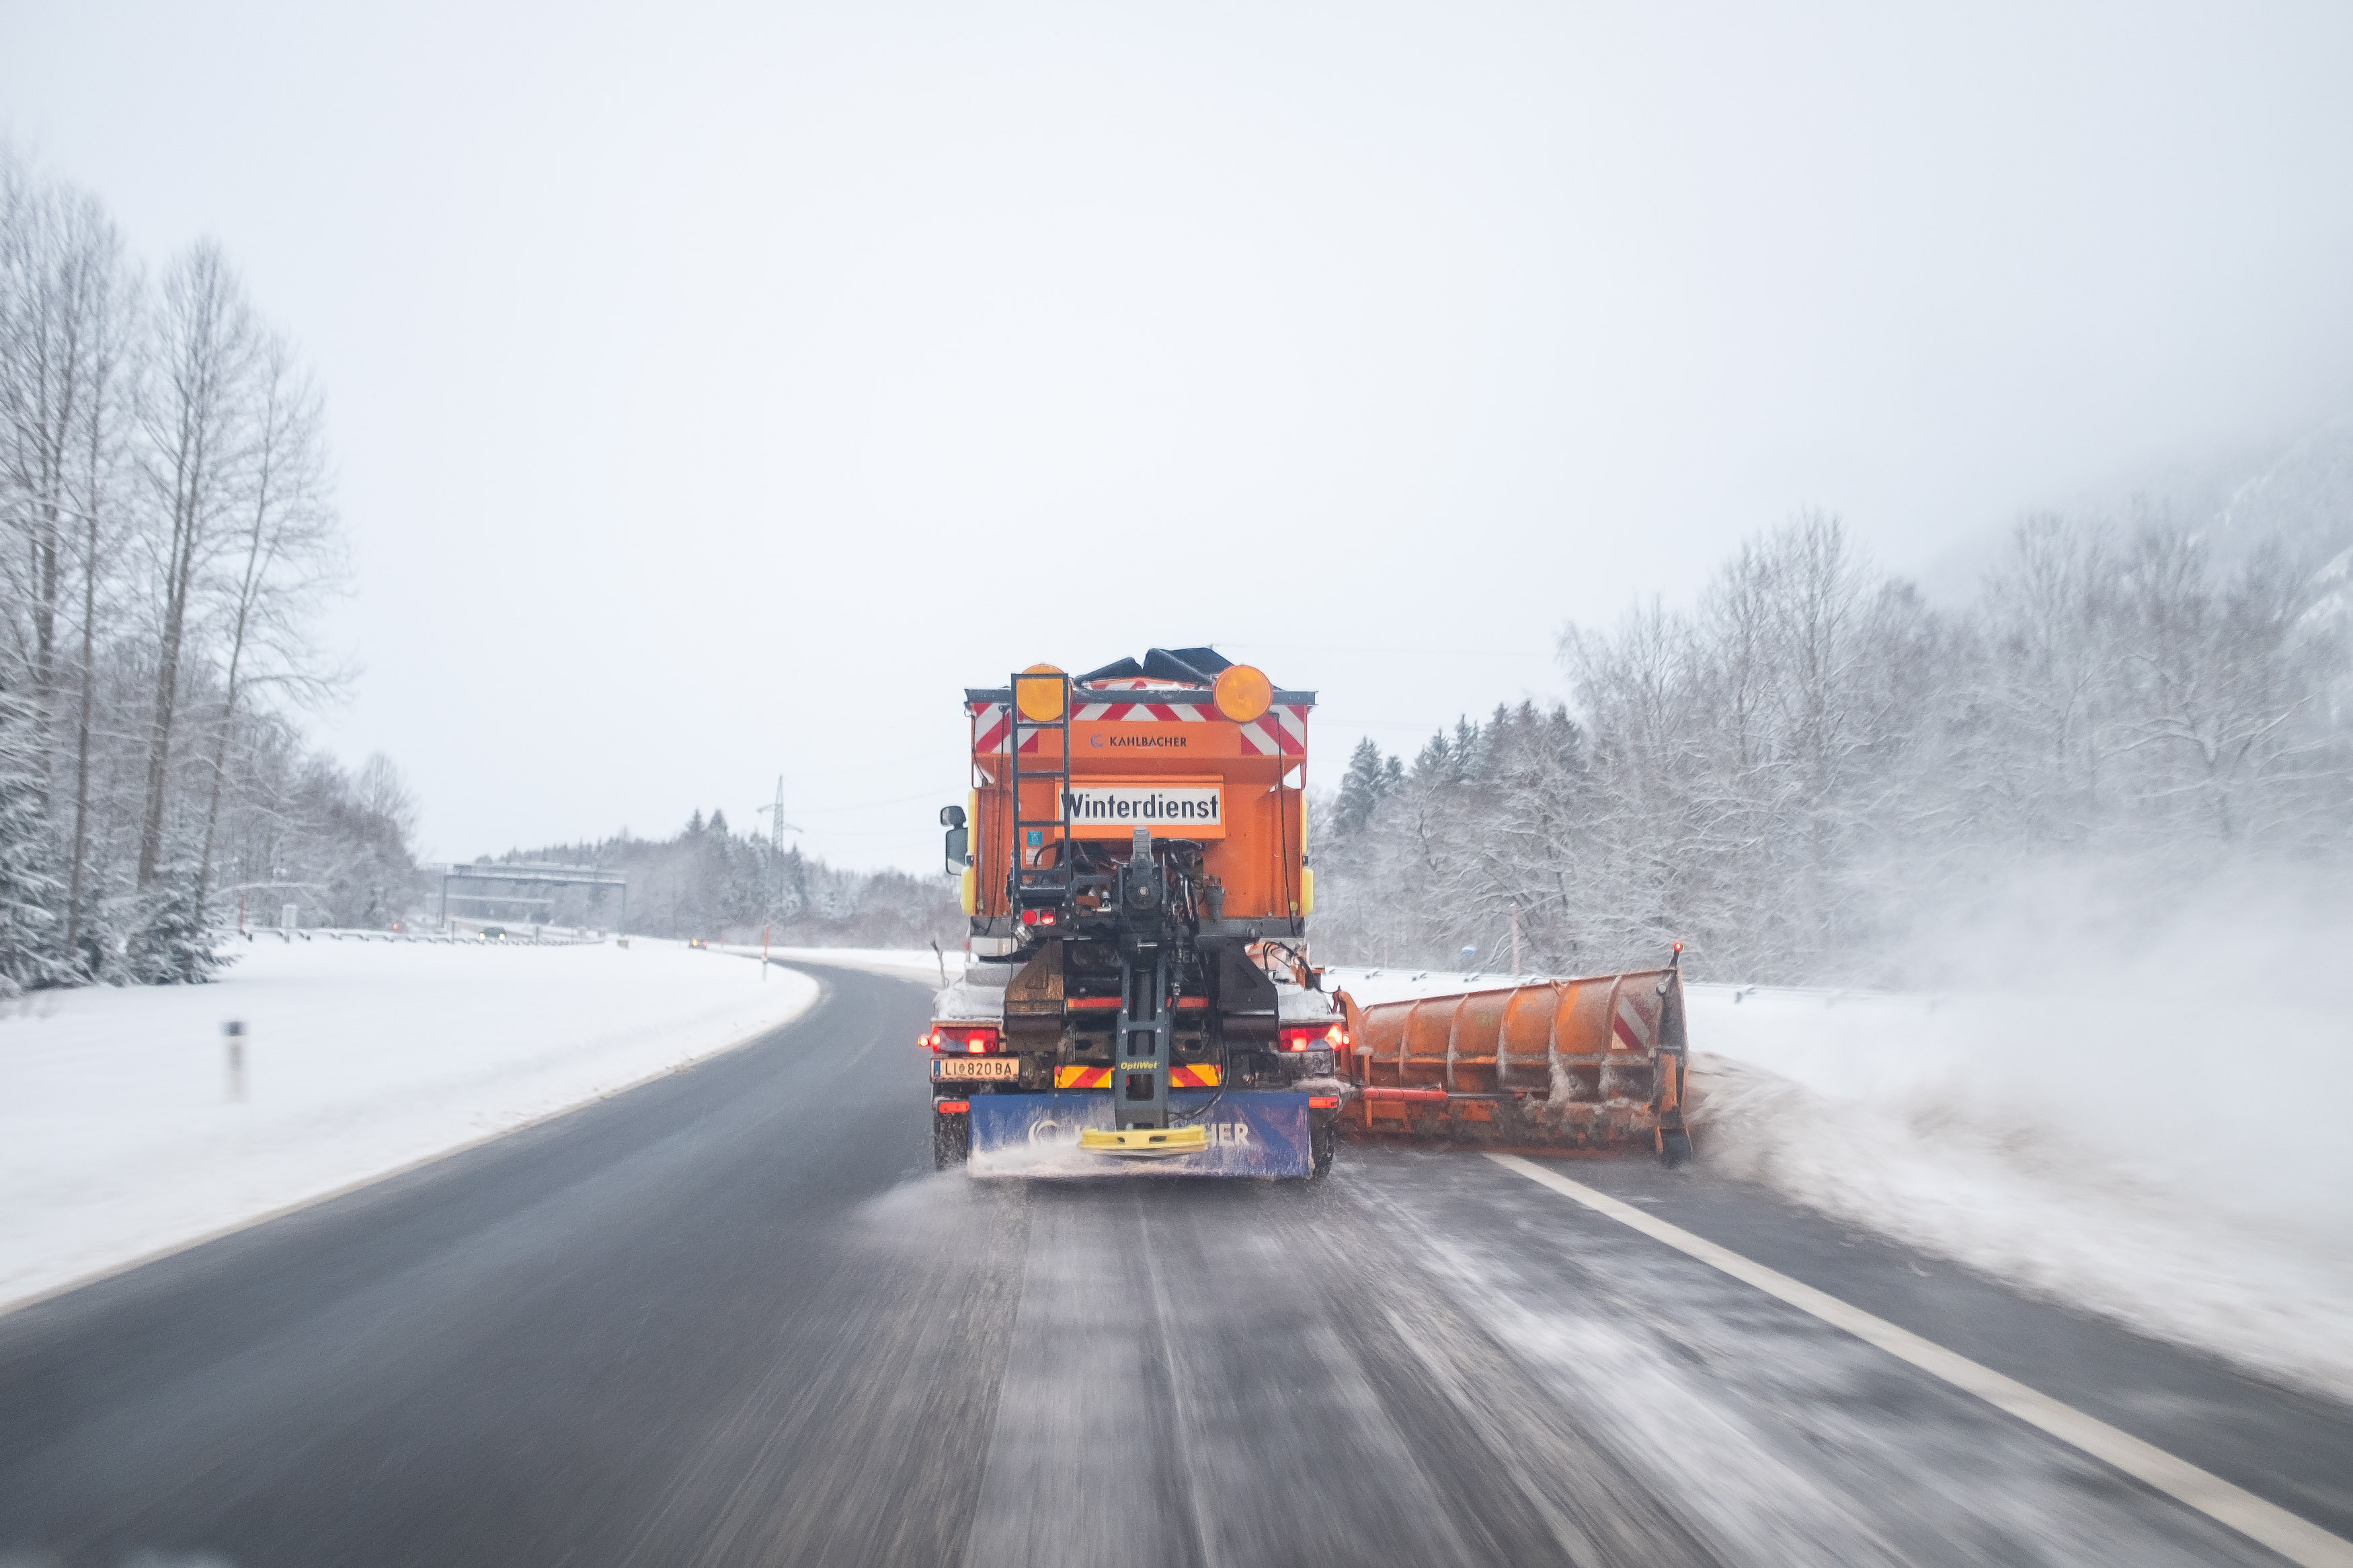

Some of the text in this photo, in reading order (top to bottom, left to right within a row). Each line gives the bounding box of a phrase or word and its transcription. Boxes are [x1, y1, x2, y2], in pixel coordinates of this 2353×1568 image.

[1109, 737, 1187, 747] KAHLBACHER
[1061, 794, 1218, 819] Winterdienst
[945, 1063, 1012, 1075] LI 820 BA
[1120, 1061, 1158, 1071] OptiWet
